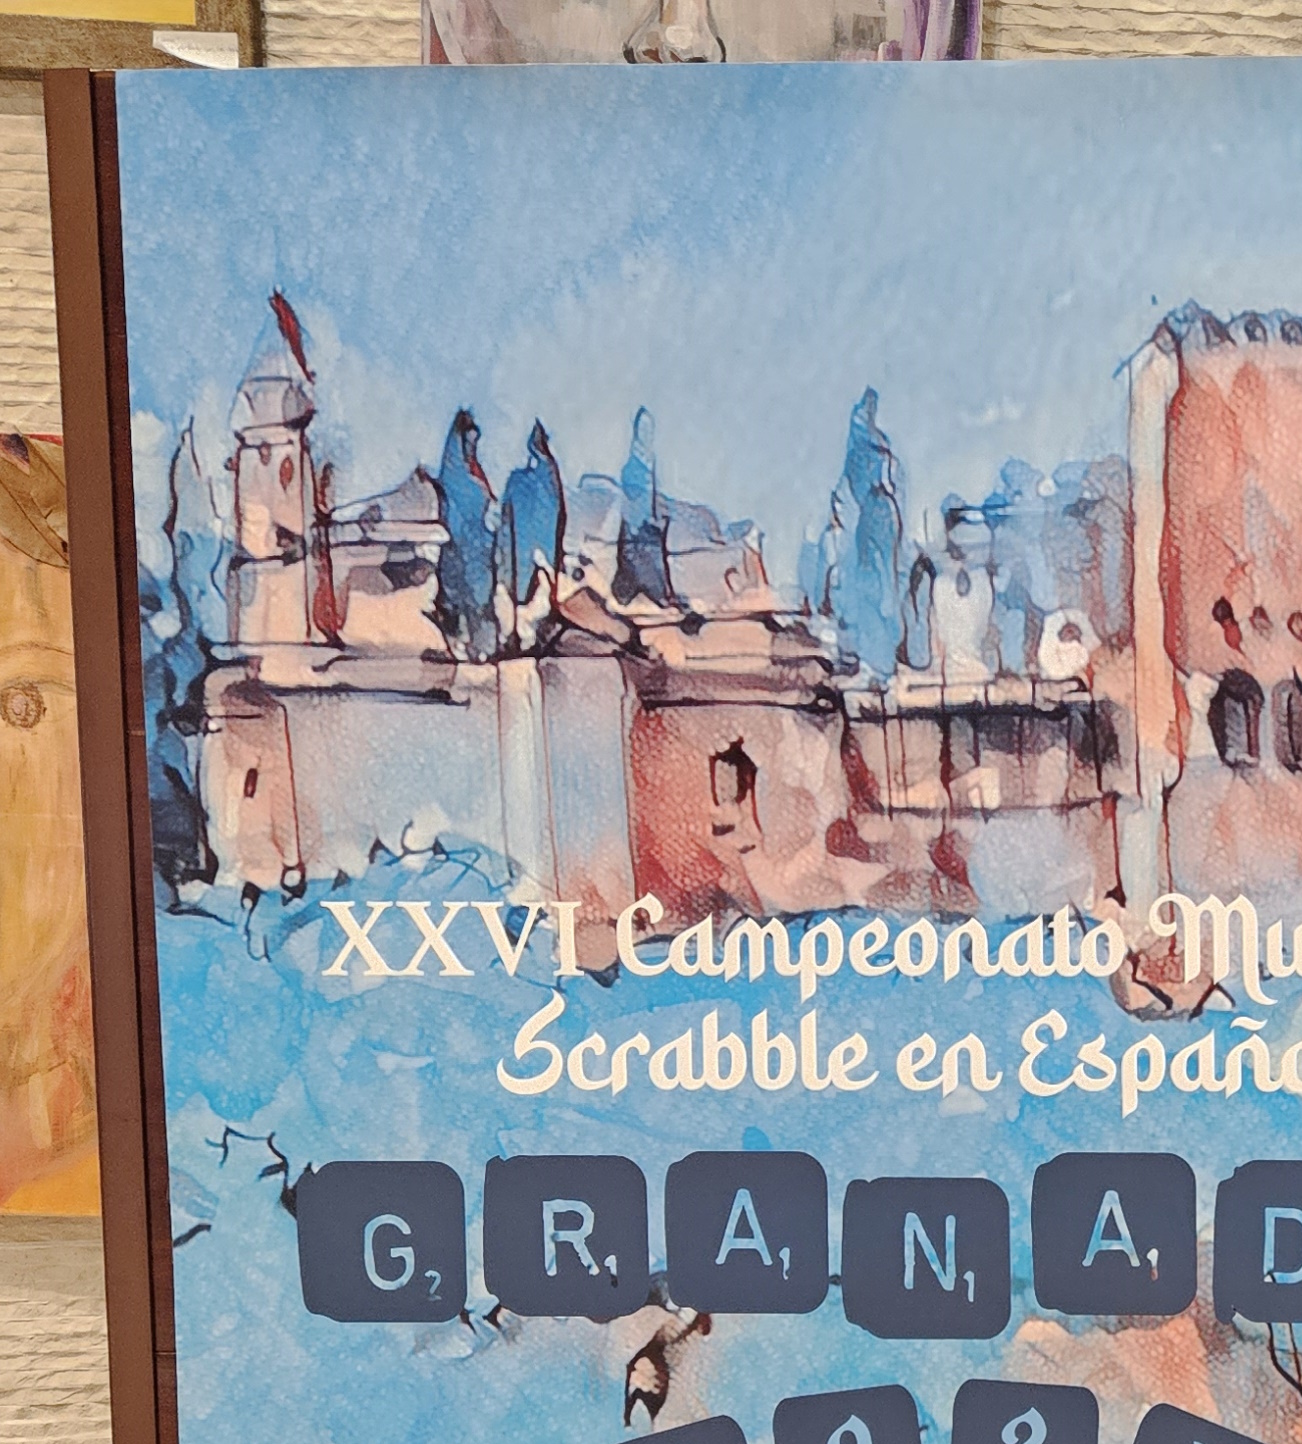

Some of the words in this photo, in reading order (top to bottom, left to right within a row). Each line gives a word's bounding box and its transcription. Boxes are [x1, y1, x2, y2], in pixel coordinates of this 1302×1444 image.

[319, 900, 586, 978] XXVI
[615, 891, 1129, 1004] Campeonato
[495, 988, 881, 1096] Scrabble
[895, 1032, 1004, 1098] en
